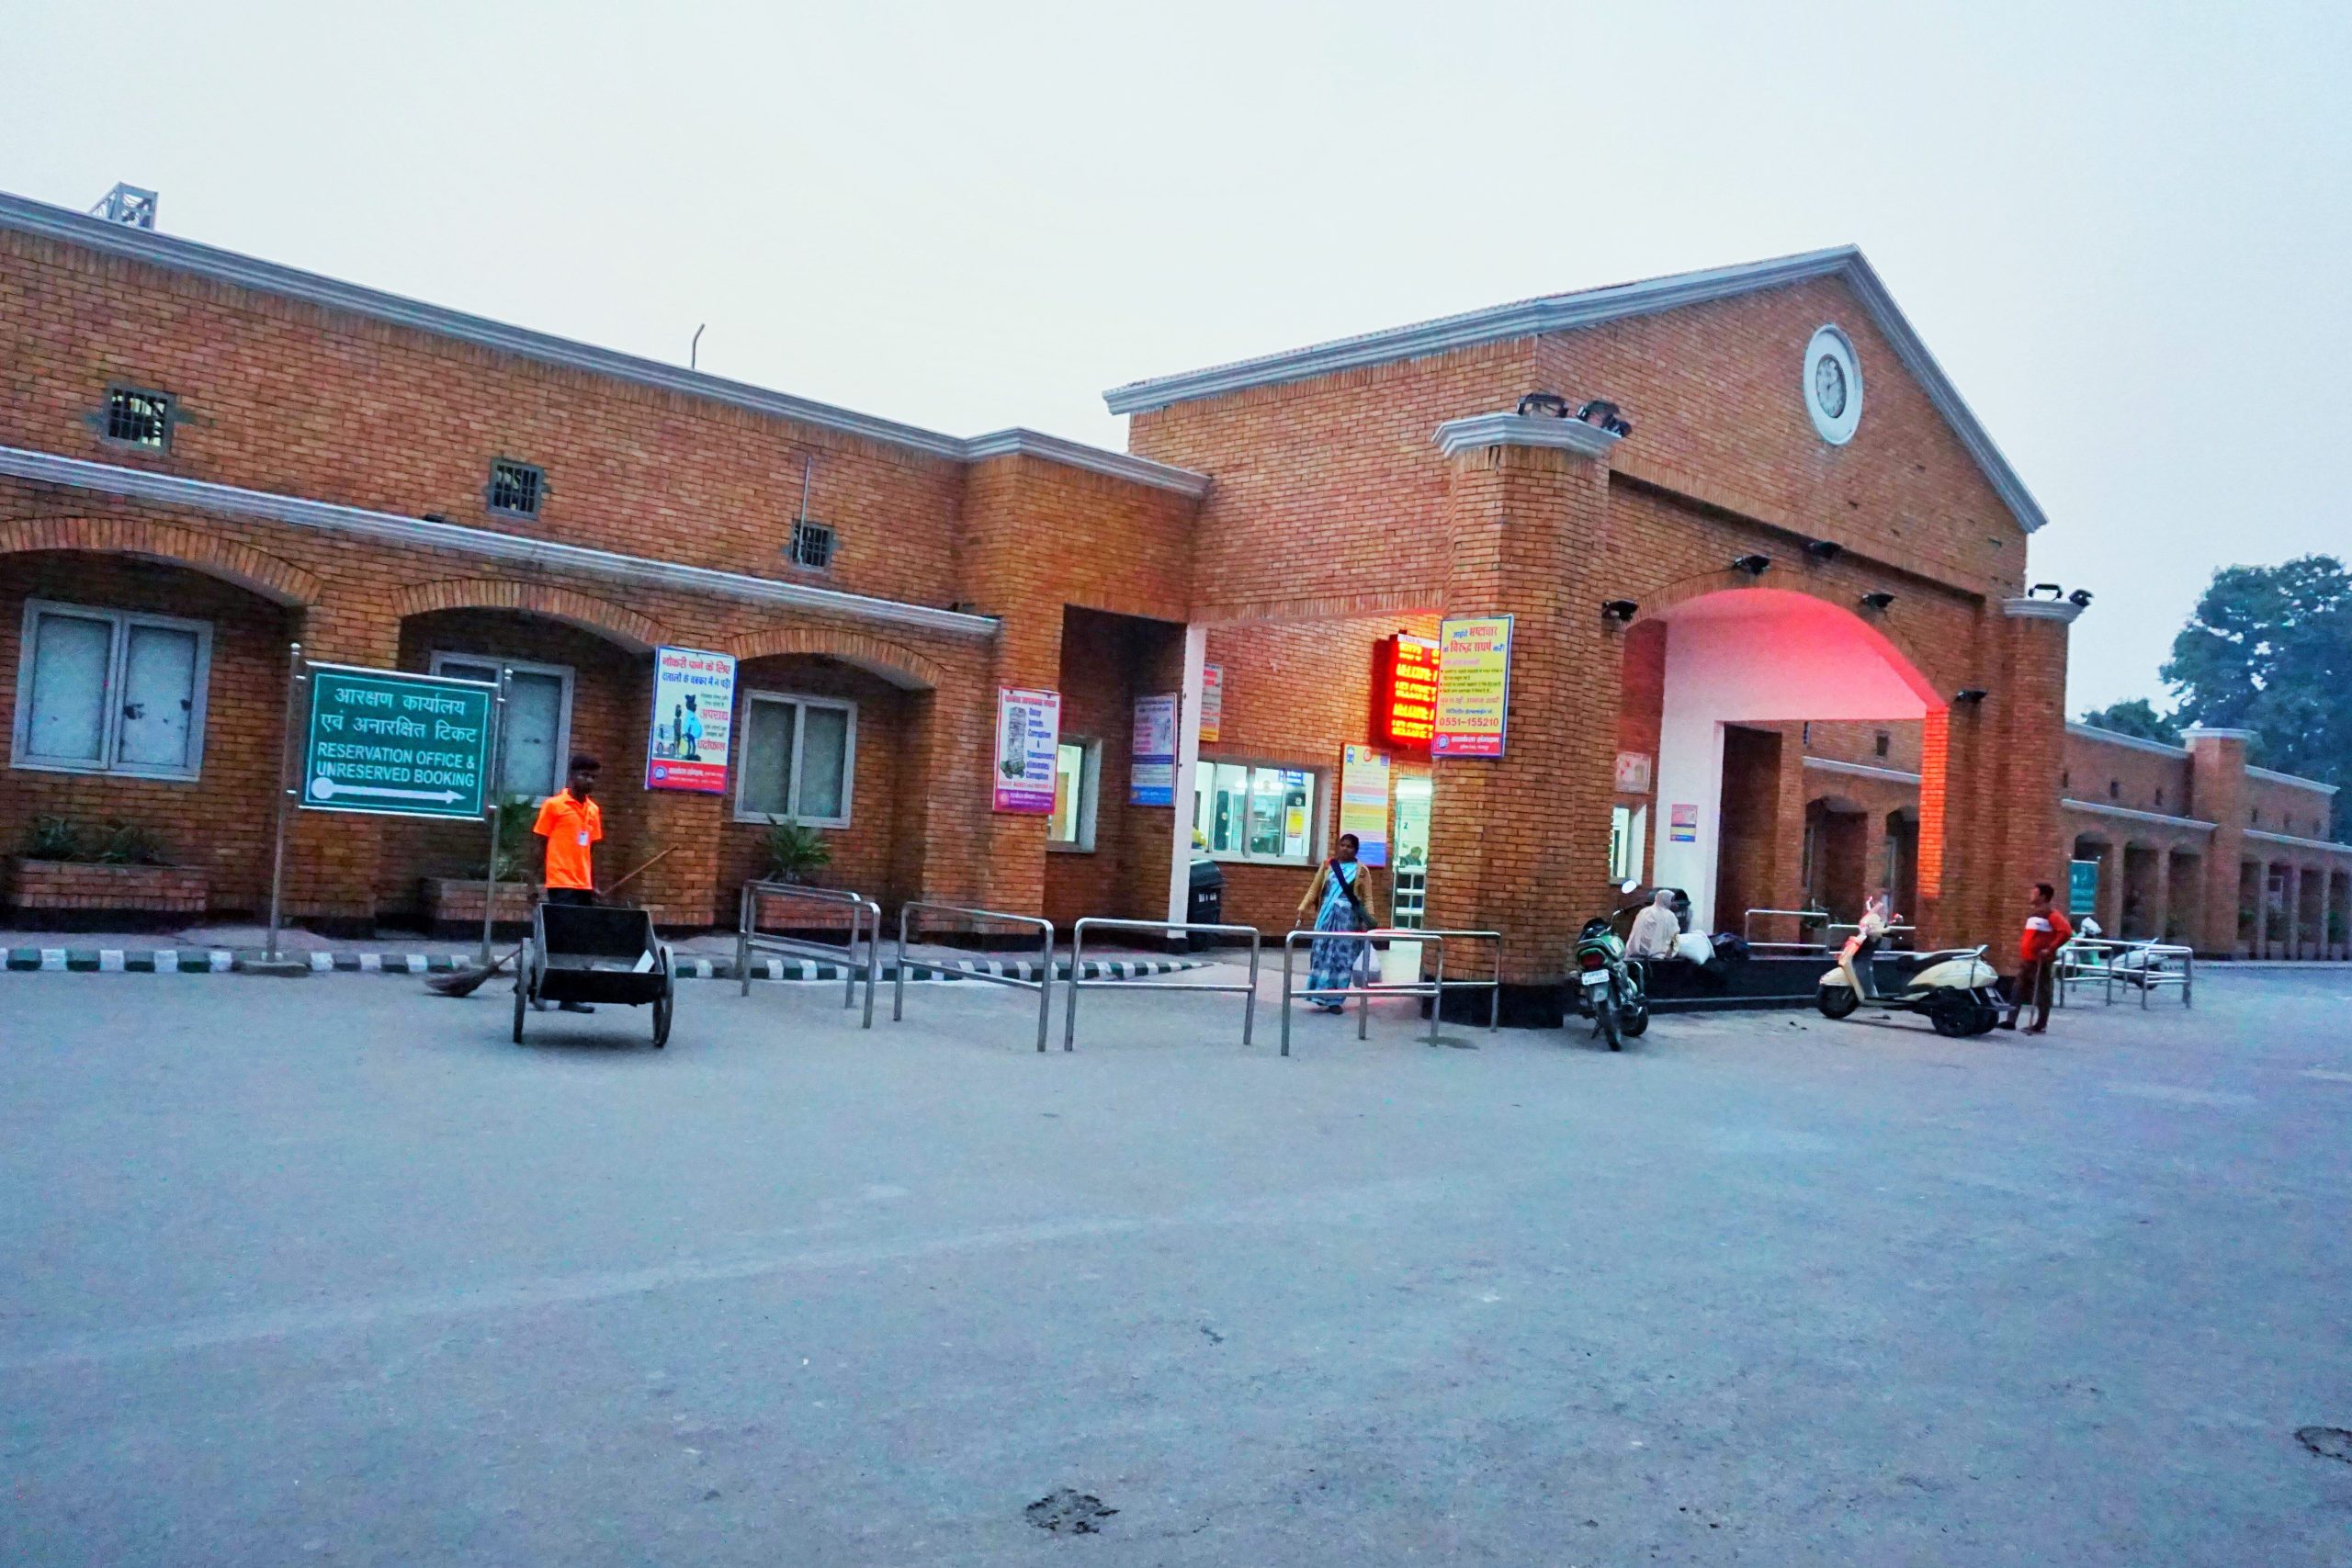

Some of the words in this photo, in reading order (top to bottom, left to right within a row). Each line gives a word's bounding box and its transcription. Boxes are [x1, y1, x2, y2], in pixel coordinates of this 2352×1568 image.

[334, 687, 393, 708] आरक्षण
[402, 693, 466, 716] कार्यालय
[320, 709, 345, 732] एवं
[353, 716, 426, 738] अनारक्षित
[435, 719, 478, 743] टिकट
[1440, 717, 1499, 727] 0551-155210
[318, 741, 413, 763] RESERVATION
[416, 750, 463, 768] OFFICE
[466, 755, 475, 770] &
[316, 761, 411, 782] UNRESERVED
[414, 771, 475, 787] BOOKING
